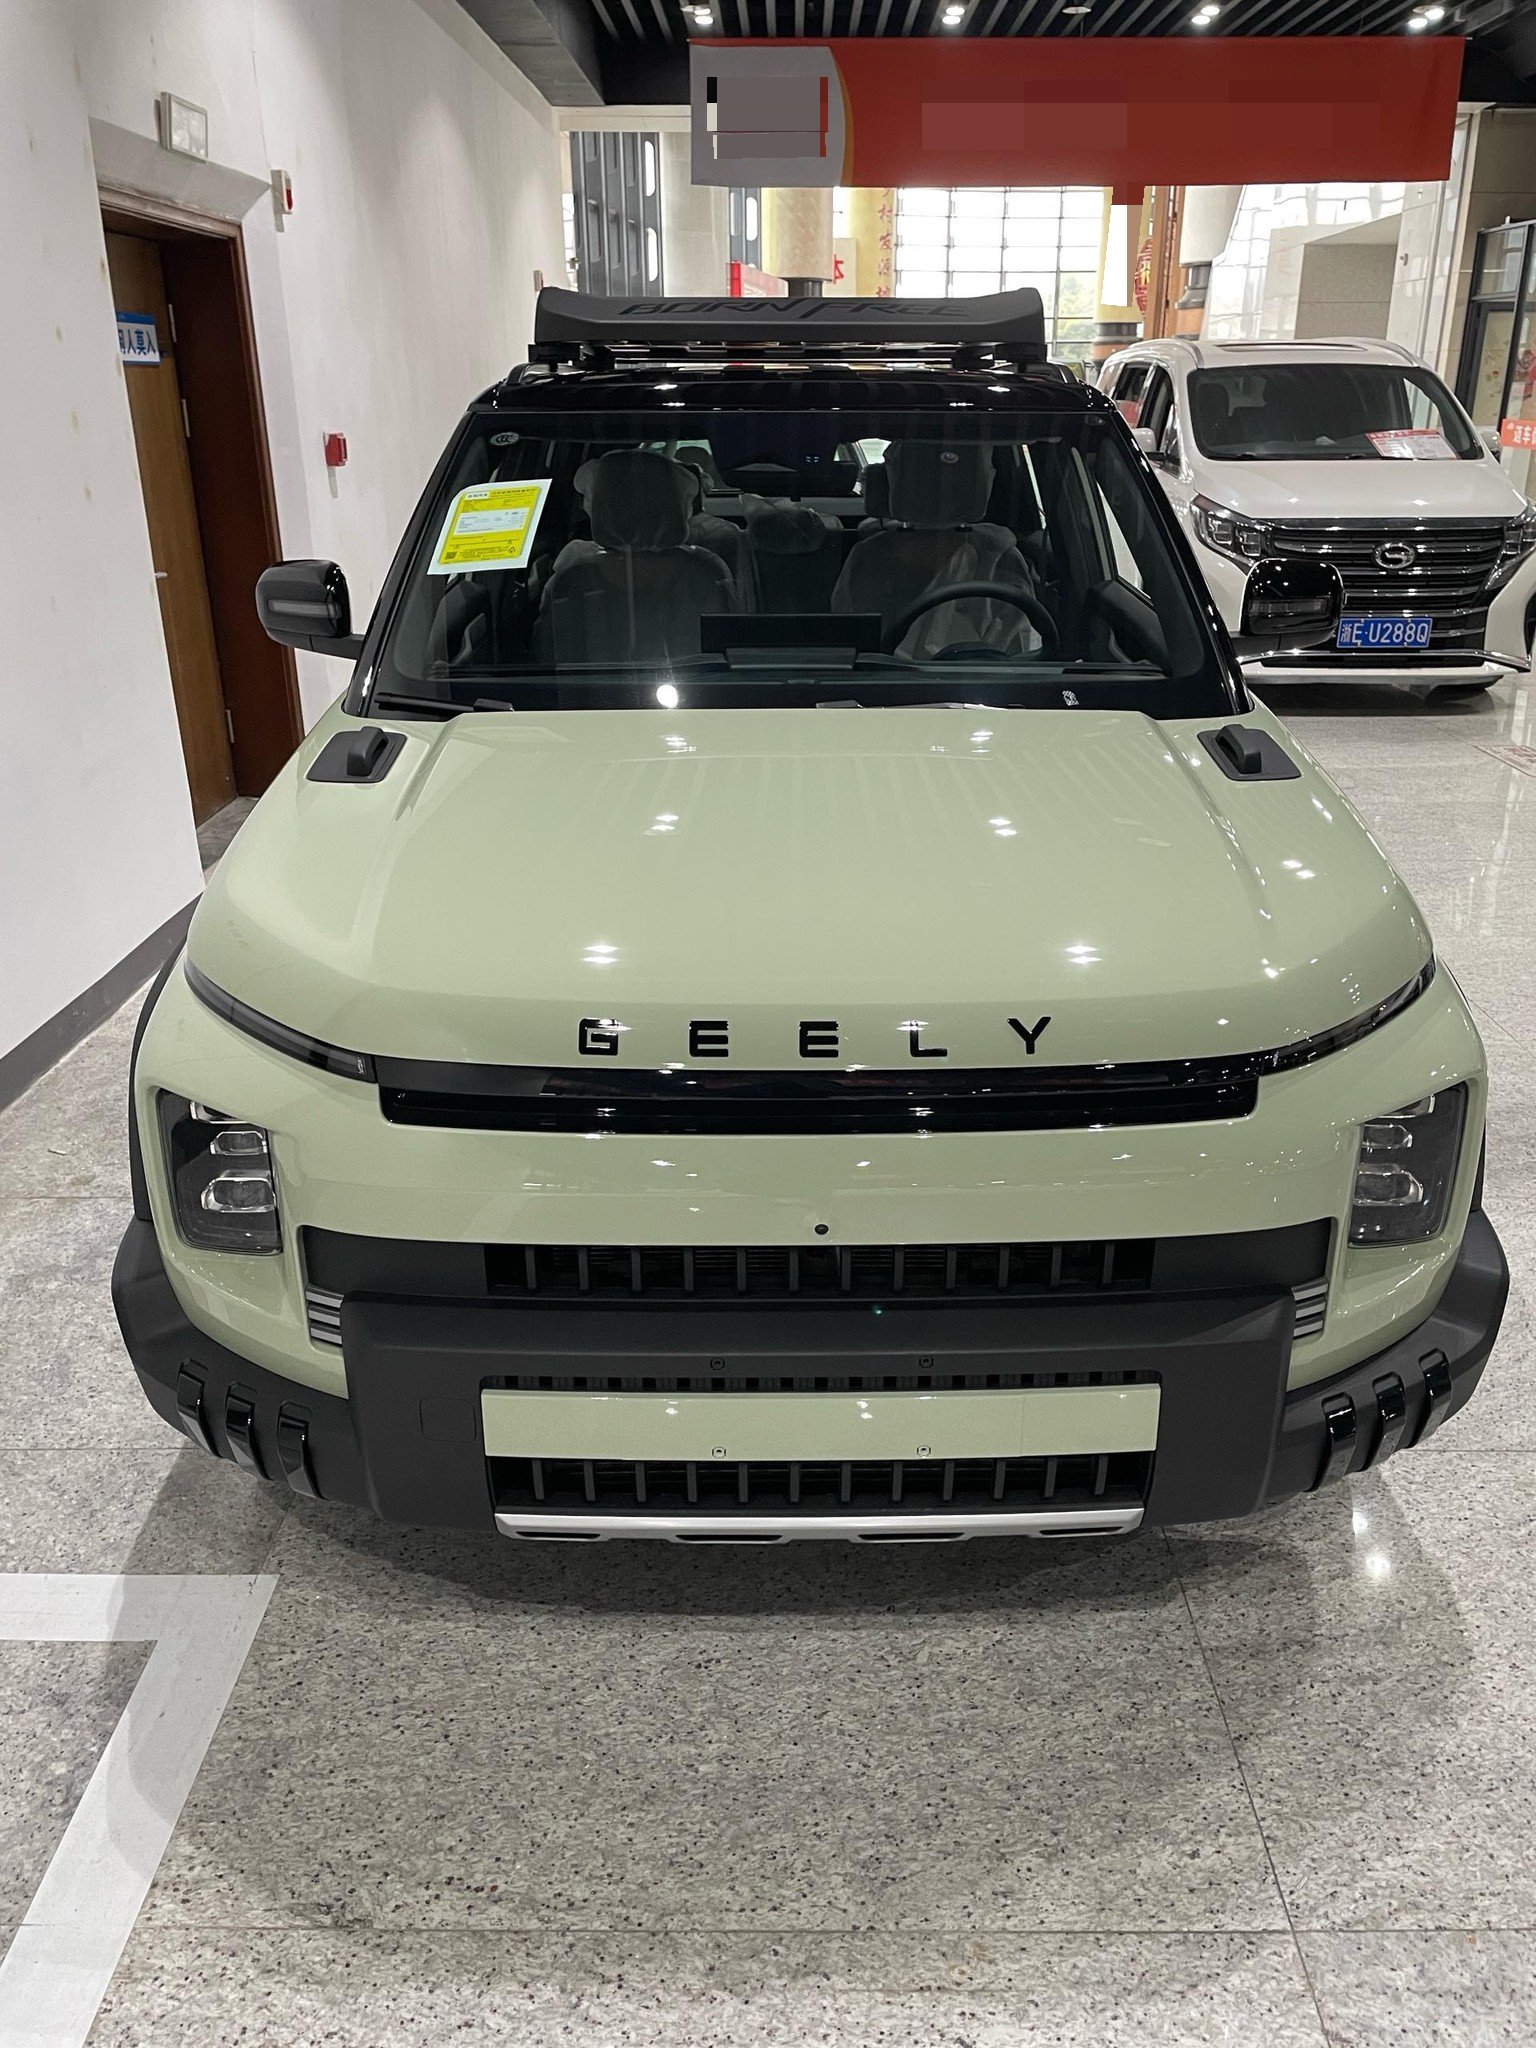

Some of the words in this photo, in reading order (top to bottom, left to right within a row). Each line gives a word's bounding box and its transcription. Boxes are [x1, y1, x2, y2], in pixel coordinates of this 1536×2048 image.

[618, 299, 801, 316] BORN
[799, 301, 969, 319] FREE
[578, 1016, 1051, 1057] GEELY
